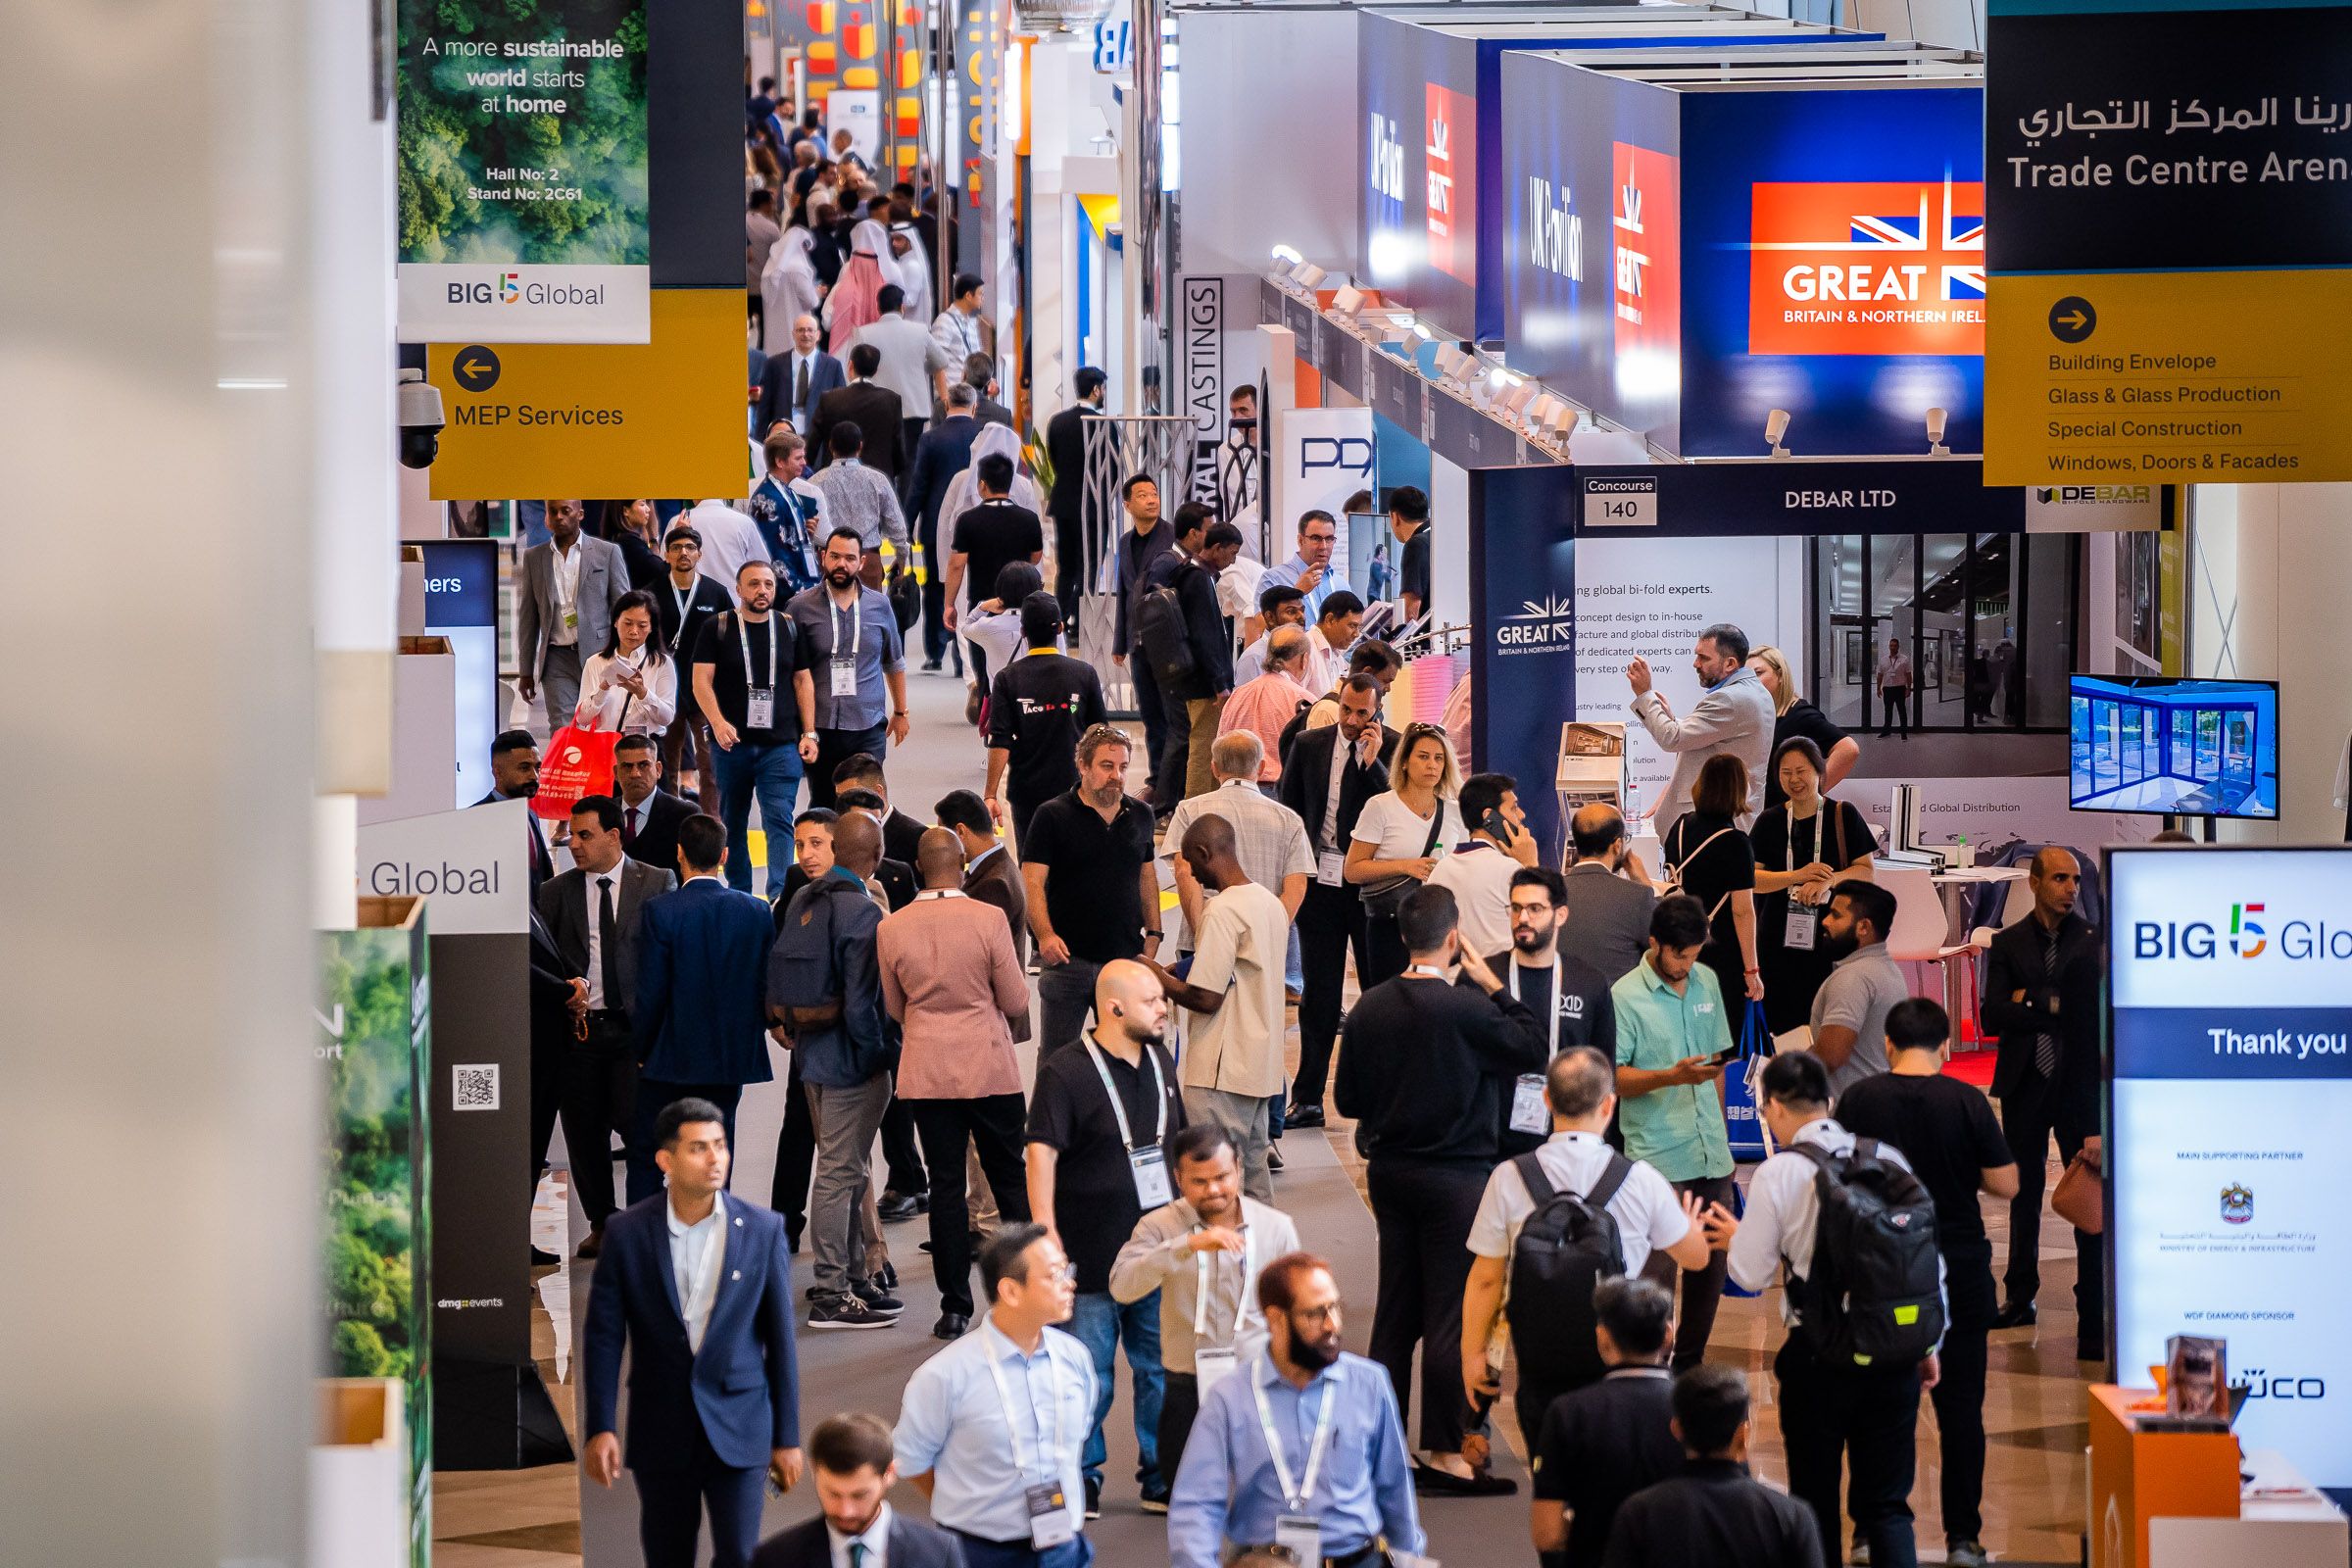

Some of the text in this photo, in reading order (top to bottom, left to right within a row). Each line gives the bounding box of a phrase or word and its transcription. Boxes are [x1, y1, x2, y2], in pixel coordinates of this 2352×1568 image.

[422, 37, 624, 59] A more sustainable
[466, 68, 585, 88] world starts
[481, 95, 567, 114] at home
[2019, 100, 2150, 147] التجاري
[2165, 97, 2278, 134] المركز
[485, 168, 560, 180] Hall No: 2
[2007, 151, 2352, 187] Trade Centre Aren
[467, 187, 582, 201] Stand No: 2C61
[1529, 175, 1544, 269] UK
[1544, 180, 1584, 283] Pavilion
[1783, 265, 1928, 302] GREAT
[447, 282, 492, 305] BIG
[525, 282, 605, 306] Global
[1784, 310, 1985, 323] BRITAIN & NORTHERN IREL
[1191, 287, 1216, 432] CASTINGS
[2048, 354, 2217, 373] Building Envelope
[2048, 386, 2281, 405] Glass & Glass Production
[455, 404, 623, 425] MEP Services
[2048, 419, 2242, 440] Special Construction
[2048, 453, 2299, 472] Windows, Doors & Facades
[1588, 479, 1653, 492] Concourse
[2062, 485, 2150, 501] DEBAR
[1786, 489, 1896, 510] DEBAR LTD
[1603, 501, 1638, 519] 140
[1592, 584, 1626, 597] global
[1629, 584, 1665, 595] bi-fold
[1668, 585, 1713, 596] experts.
[1575, 613, 1612, 623] concept
[1615, 612, 1646, 623] design
[1661, 612, 1703, 621] in-house
[1496, 624, 1549, 645] GREAT
[1610, 629, 1628, 639] and
[1631, 629, 1659, 640] global
[1575, 647, 1585, 657] of
[1588, 647, 1634, 657] dedicated
[1637, 647, 1672, 657] experts
[1597, 665, 1618, 674] step
[1595, 703, 1622, 711] leading
[1929, 803, 1960, 813] Global
[1963, 803, 2021, 812] Distribution
[370, 860, 499, 896] Global
[2134, 921, 2216, 959] BIG
[2207, 1027, 2347, 1060] Thank you
[2177, 1151, 2200, 1160] MAIN
[2261, 1151, 2304, 1160] PARTNER
[2206, 1311, 2249, 1321] DIAMOND
[2251, 1311, 2295, 1321] SPONSOR
